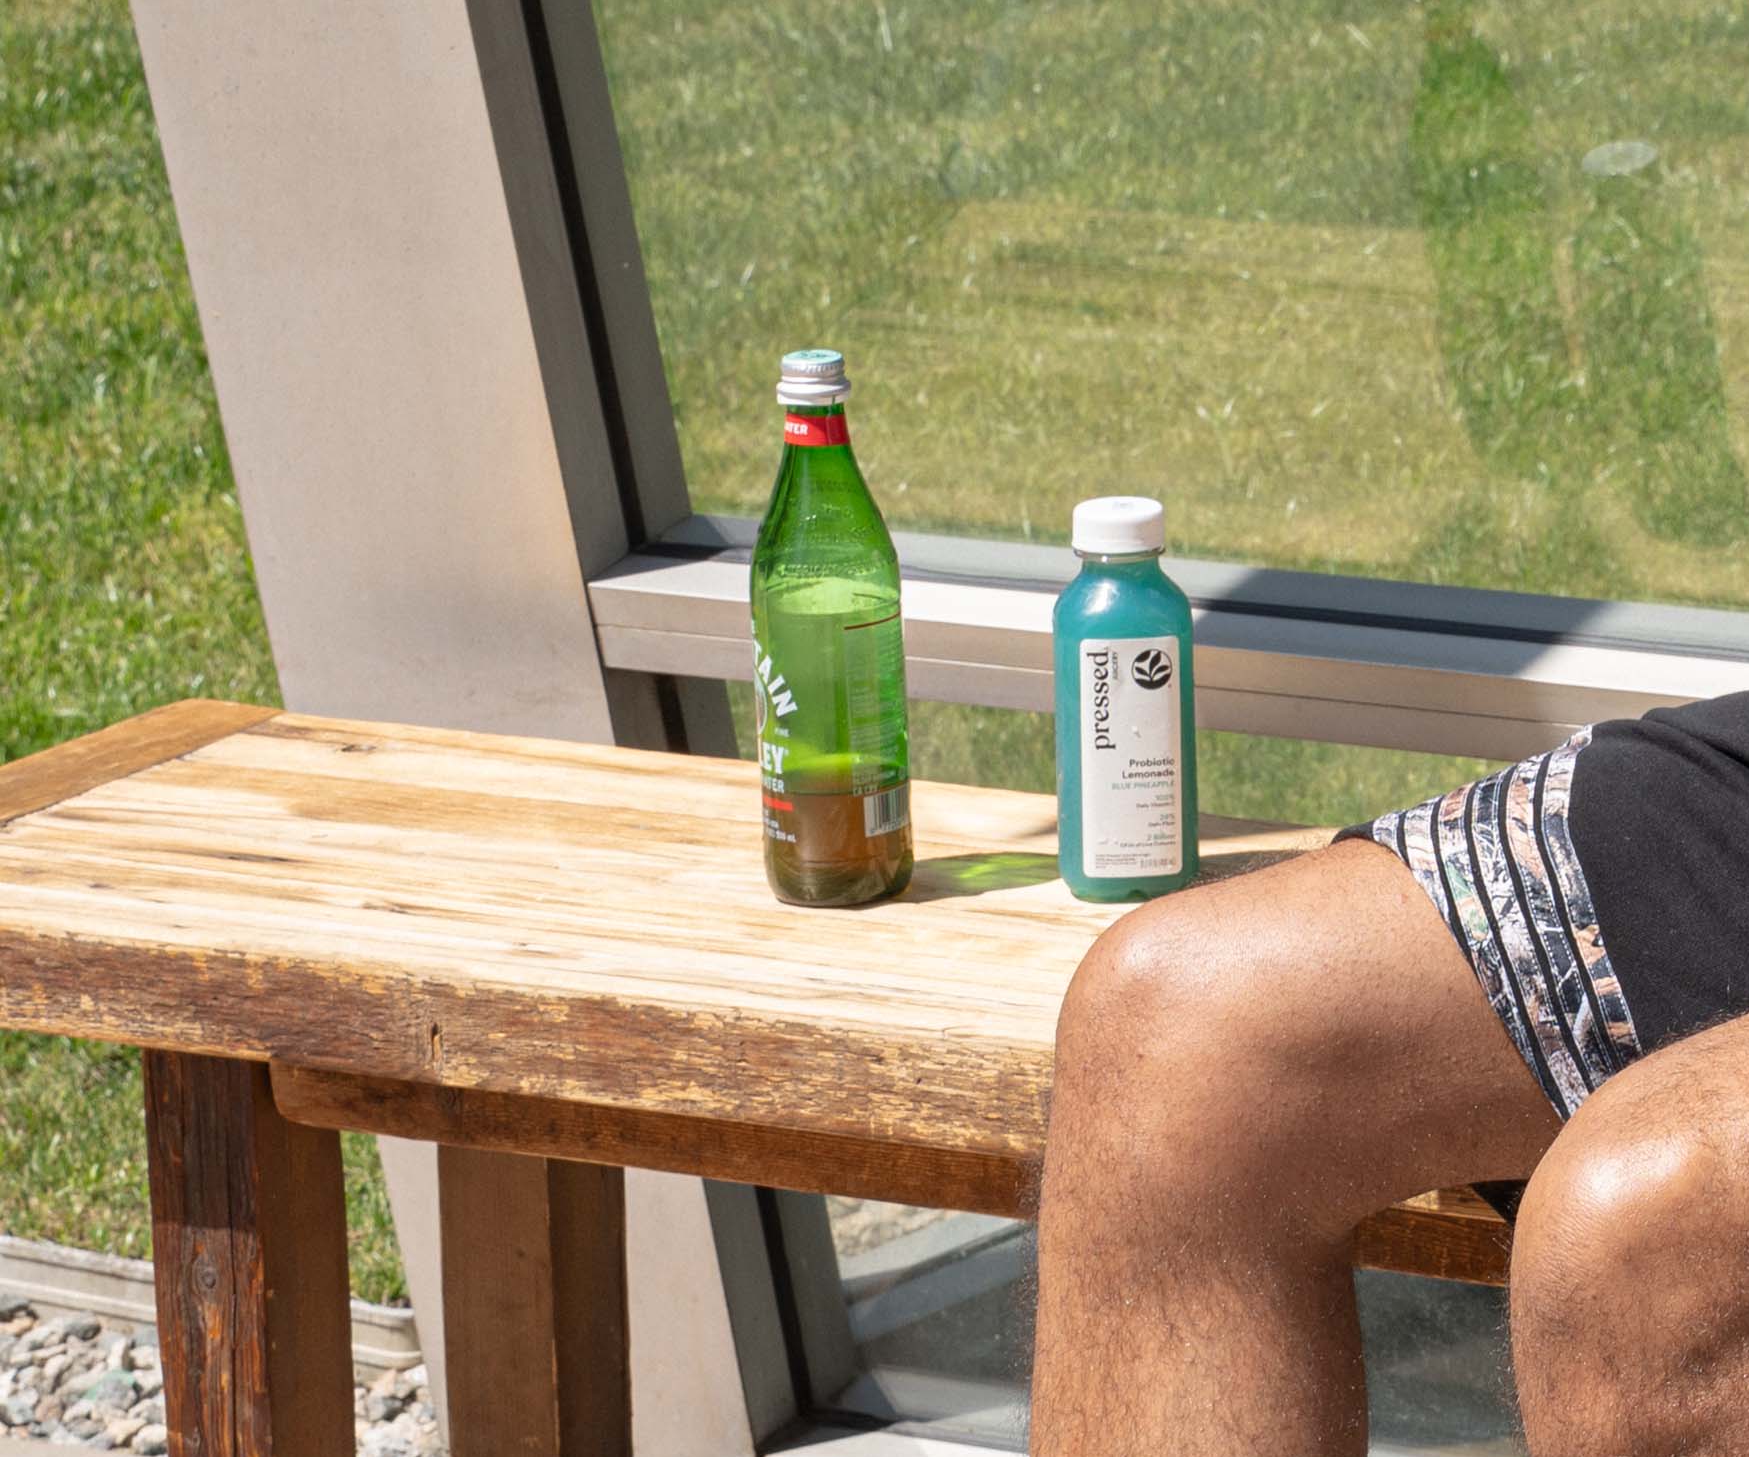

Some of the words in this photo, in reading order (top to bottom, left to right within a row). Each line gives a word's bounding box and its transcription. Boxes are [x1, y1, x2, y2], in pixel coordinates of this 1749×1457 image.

[1086, 651, 1116, 750] pressed
[1129, 757, 1175, 767] Probiotic
[1122, 768, 1175, 779] Lemonade
